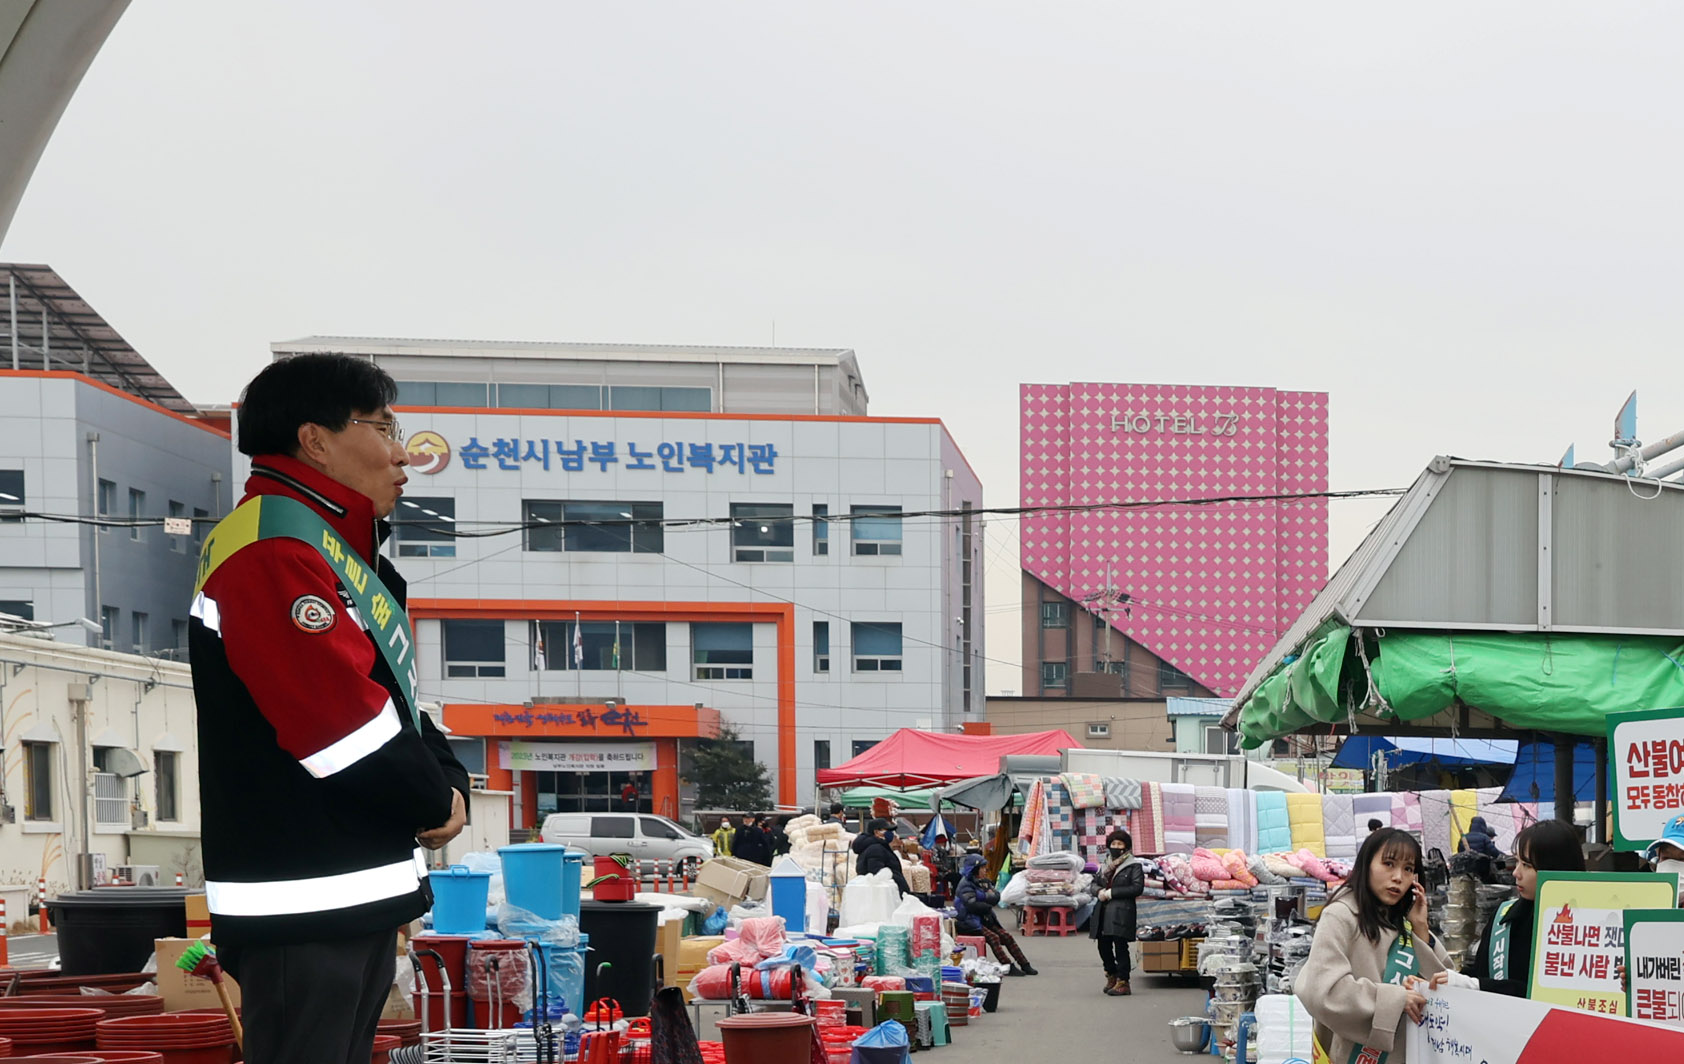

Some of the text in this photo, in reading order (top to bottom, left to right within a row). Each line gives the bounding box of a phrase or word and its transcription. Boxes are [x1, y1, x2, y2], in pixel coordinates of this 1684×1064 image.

[1111, 415, 1203, 434] HOTEL
[625, 441, 778, 475] 노인복지관
[1627, 785, 1650, 810] 모두
[1547, 924, 1601, 947] 산불나면
[1544, 951, 1575, 977] 불낸
[1579, 954, 1610, 979] 사람
[1577, 998, 1618, 1014] 산불조심
